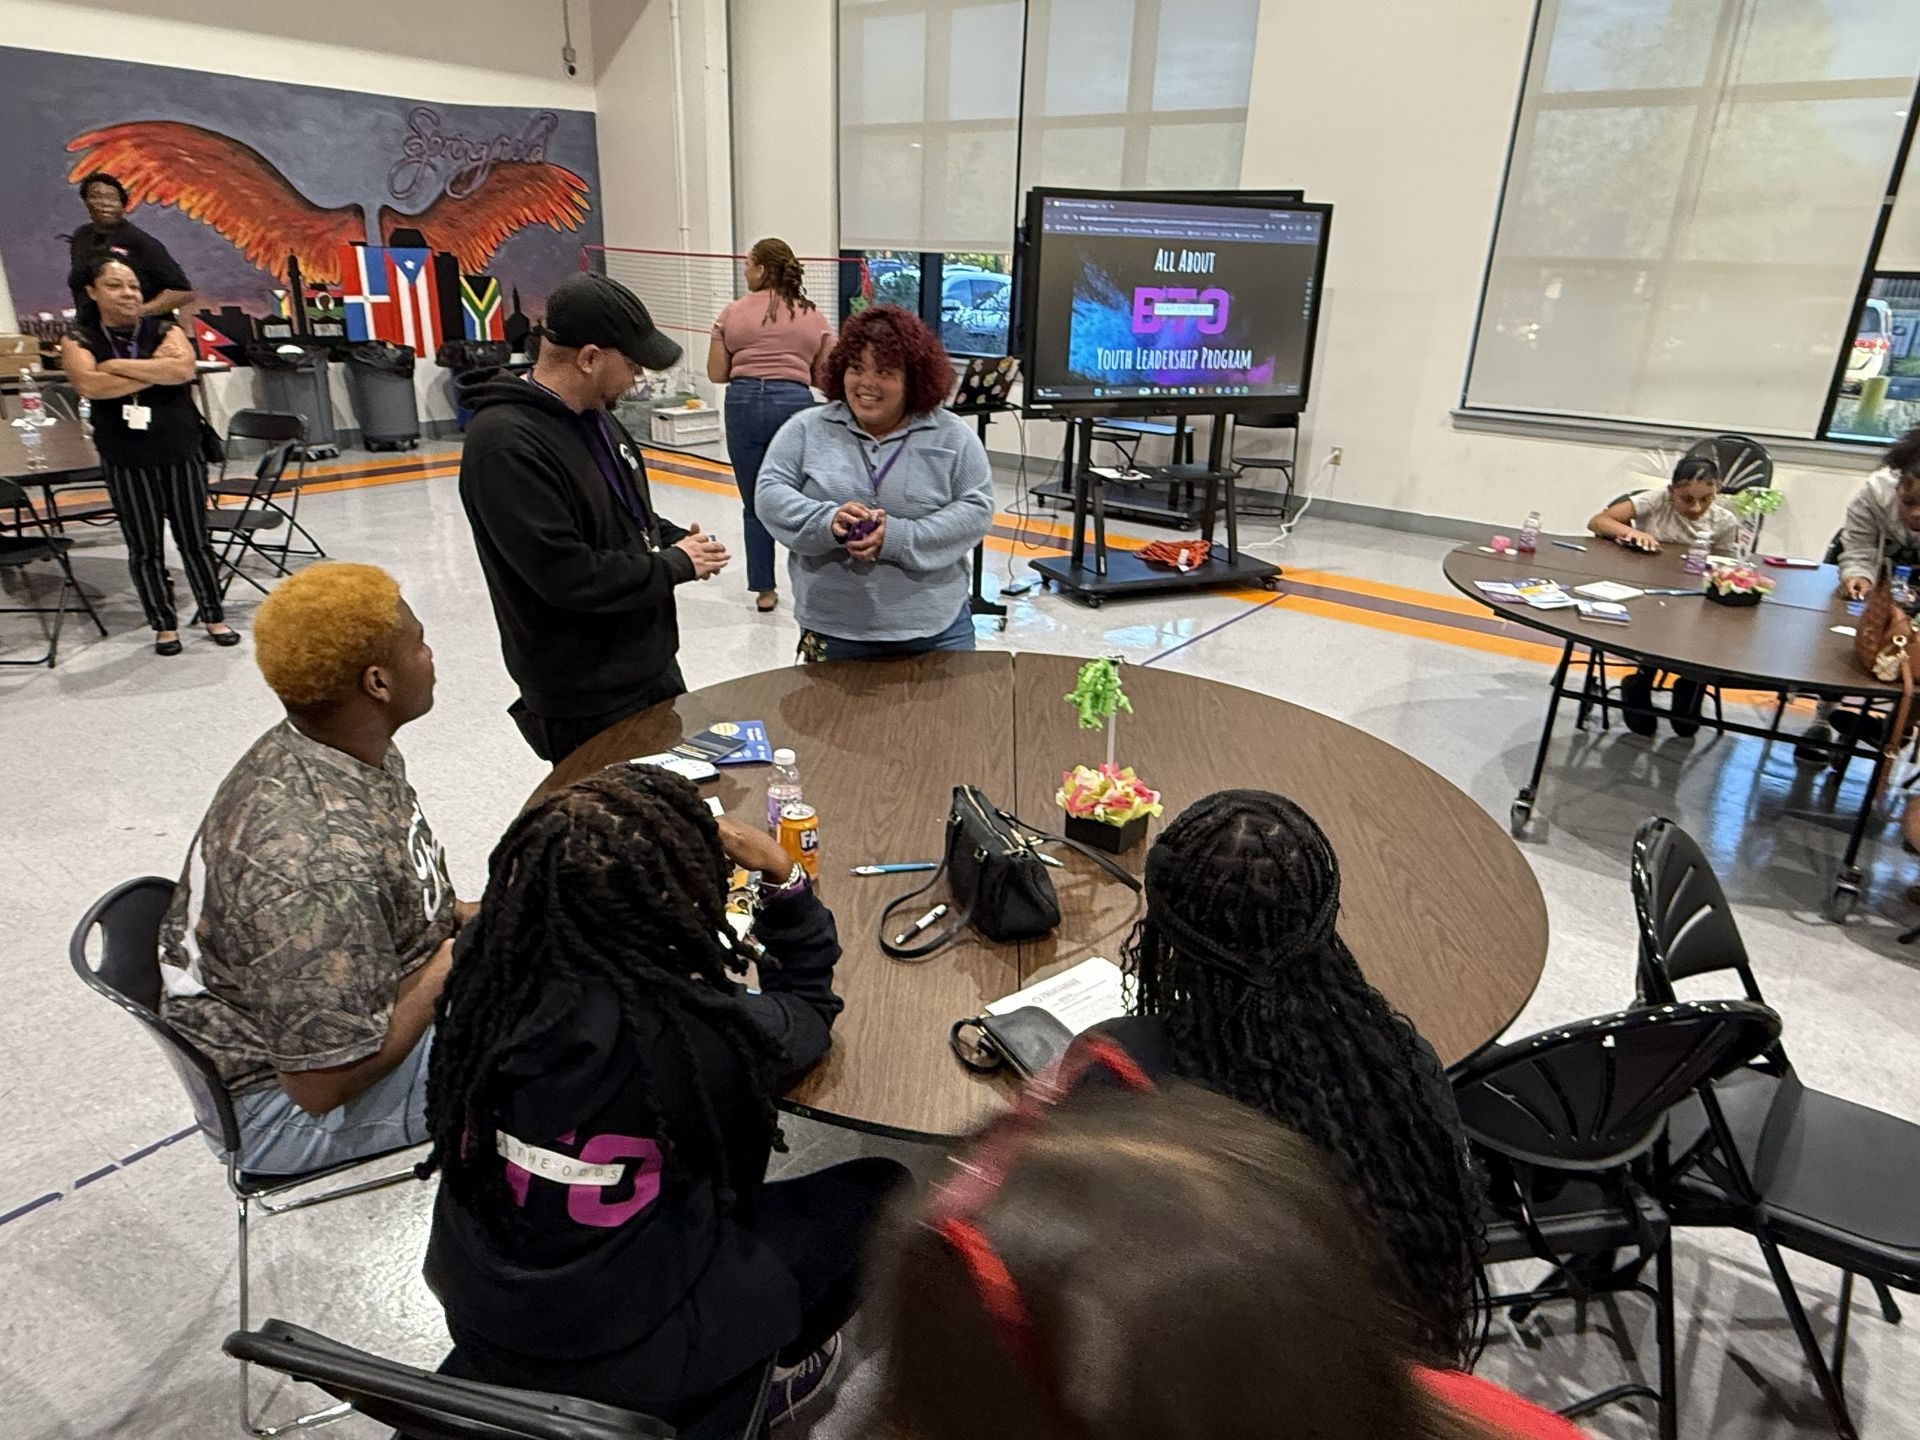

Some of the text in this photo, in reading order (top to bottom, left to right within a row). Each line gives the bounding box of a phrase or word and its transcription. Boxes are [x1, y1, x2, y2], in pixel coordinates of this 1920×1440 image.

[387, 106, 559, 200] Springfield
[1153, 247, 1216, 274] ALL ABOUT
[1096, 346, 1252, 370] YOUTH LEADERSHIP PROGRAM
[515, 1146, 550, 1170] THE
